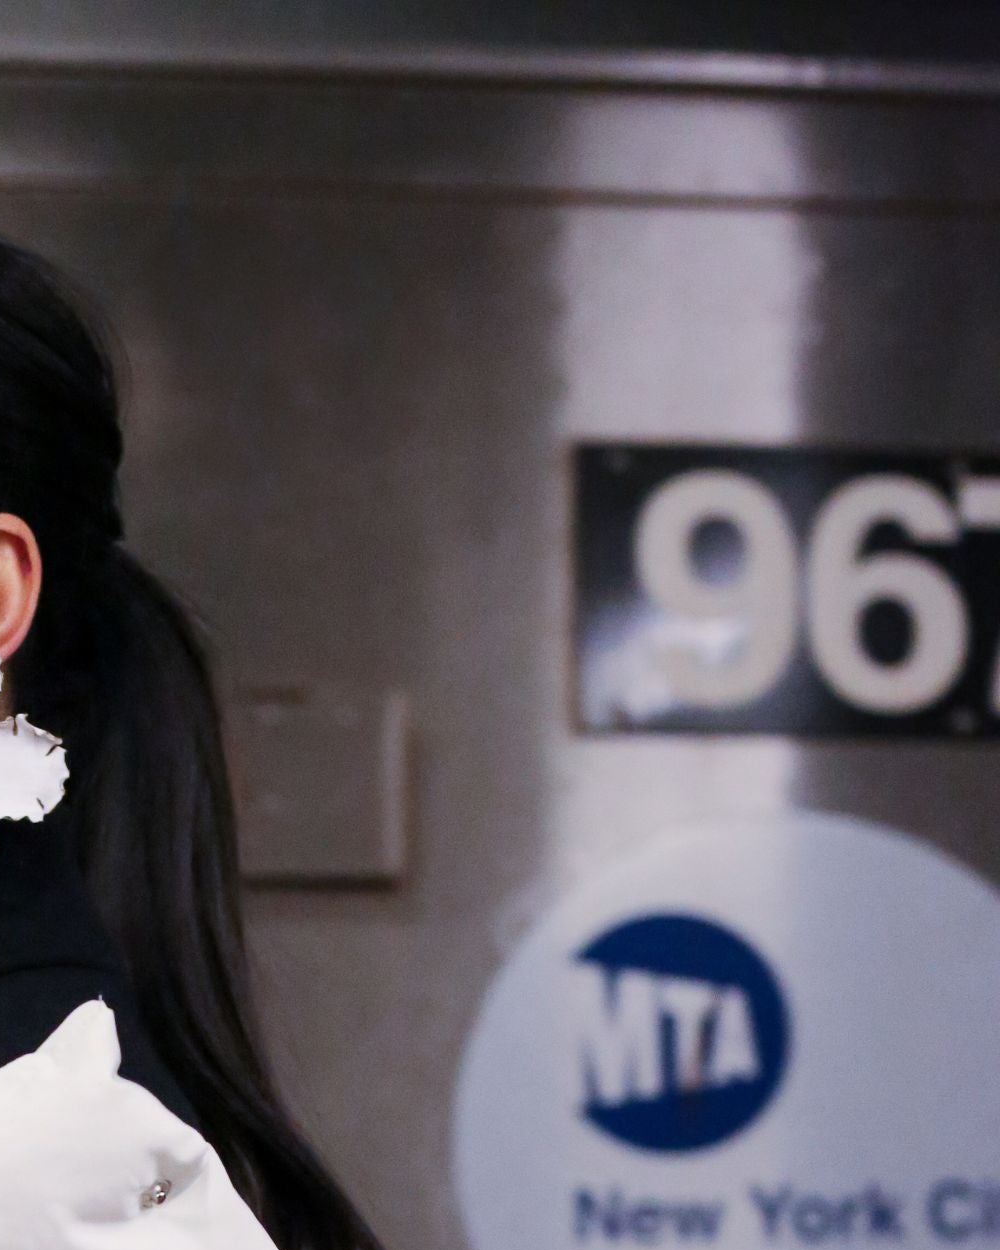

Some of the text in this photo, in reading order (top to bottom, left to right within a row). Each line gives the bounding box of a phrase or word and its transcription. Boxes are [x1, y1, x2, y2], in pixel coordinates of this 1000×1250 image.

[632, 466, 1000, 715] 96
[570, 957, 764, 1109] MTA
[574, 1186, 724, 1244] New
[749, 1181, 904, 1243] York
